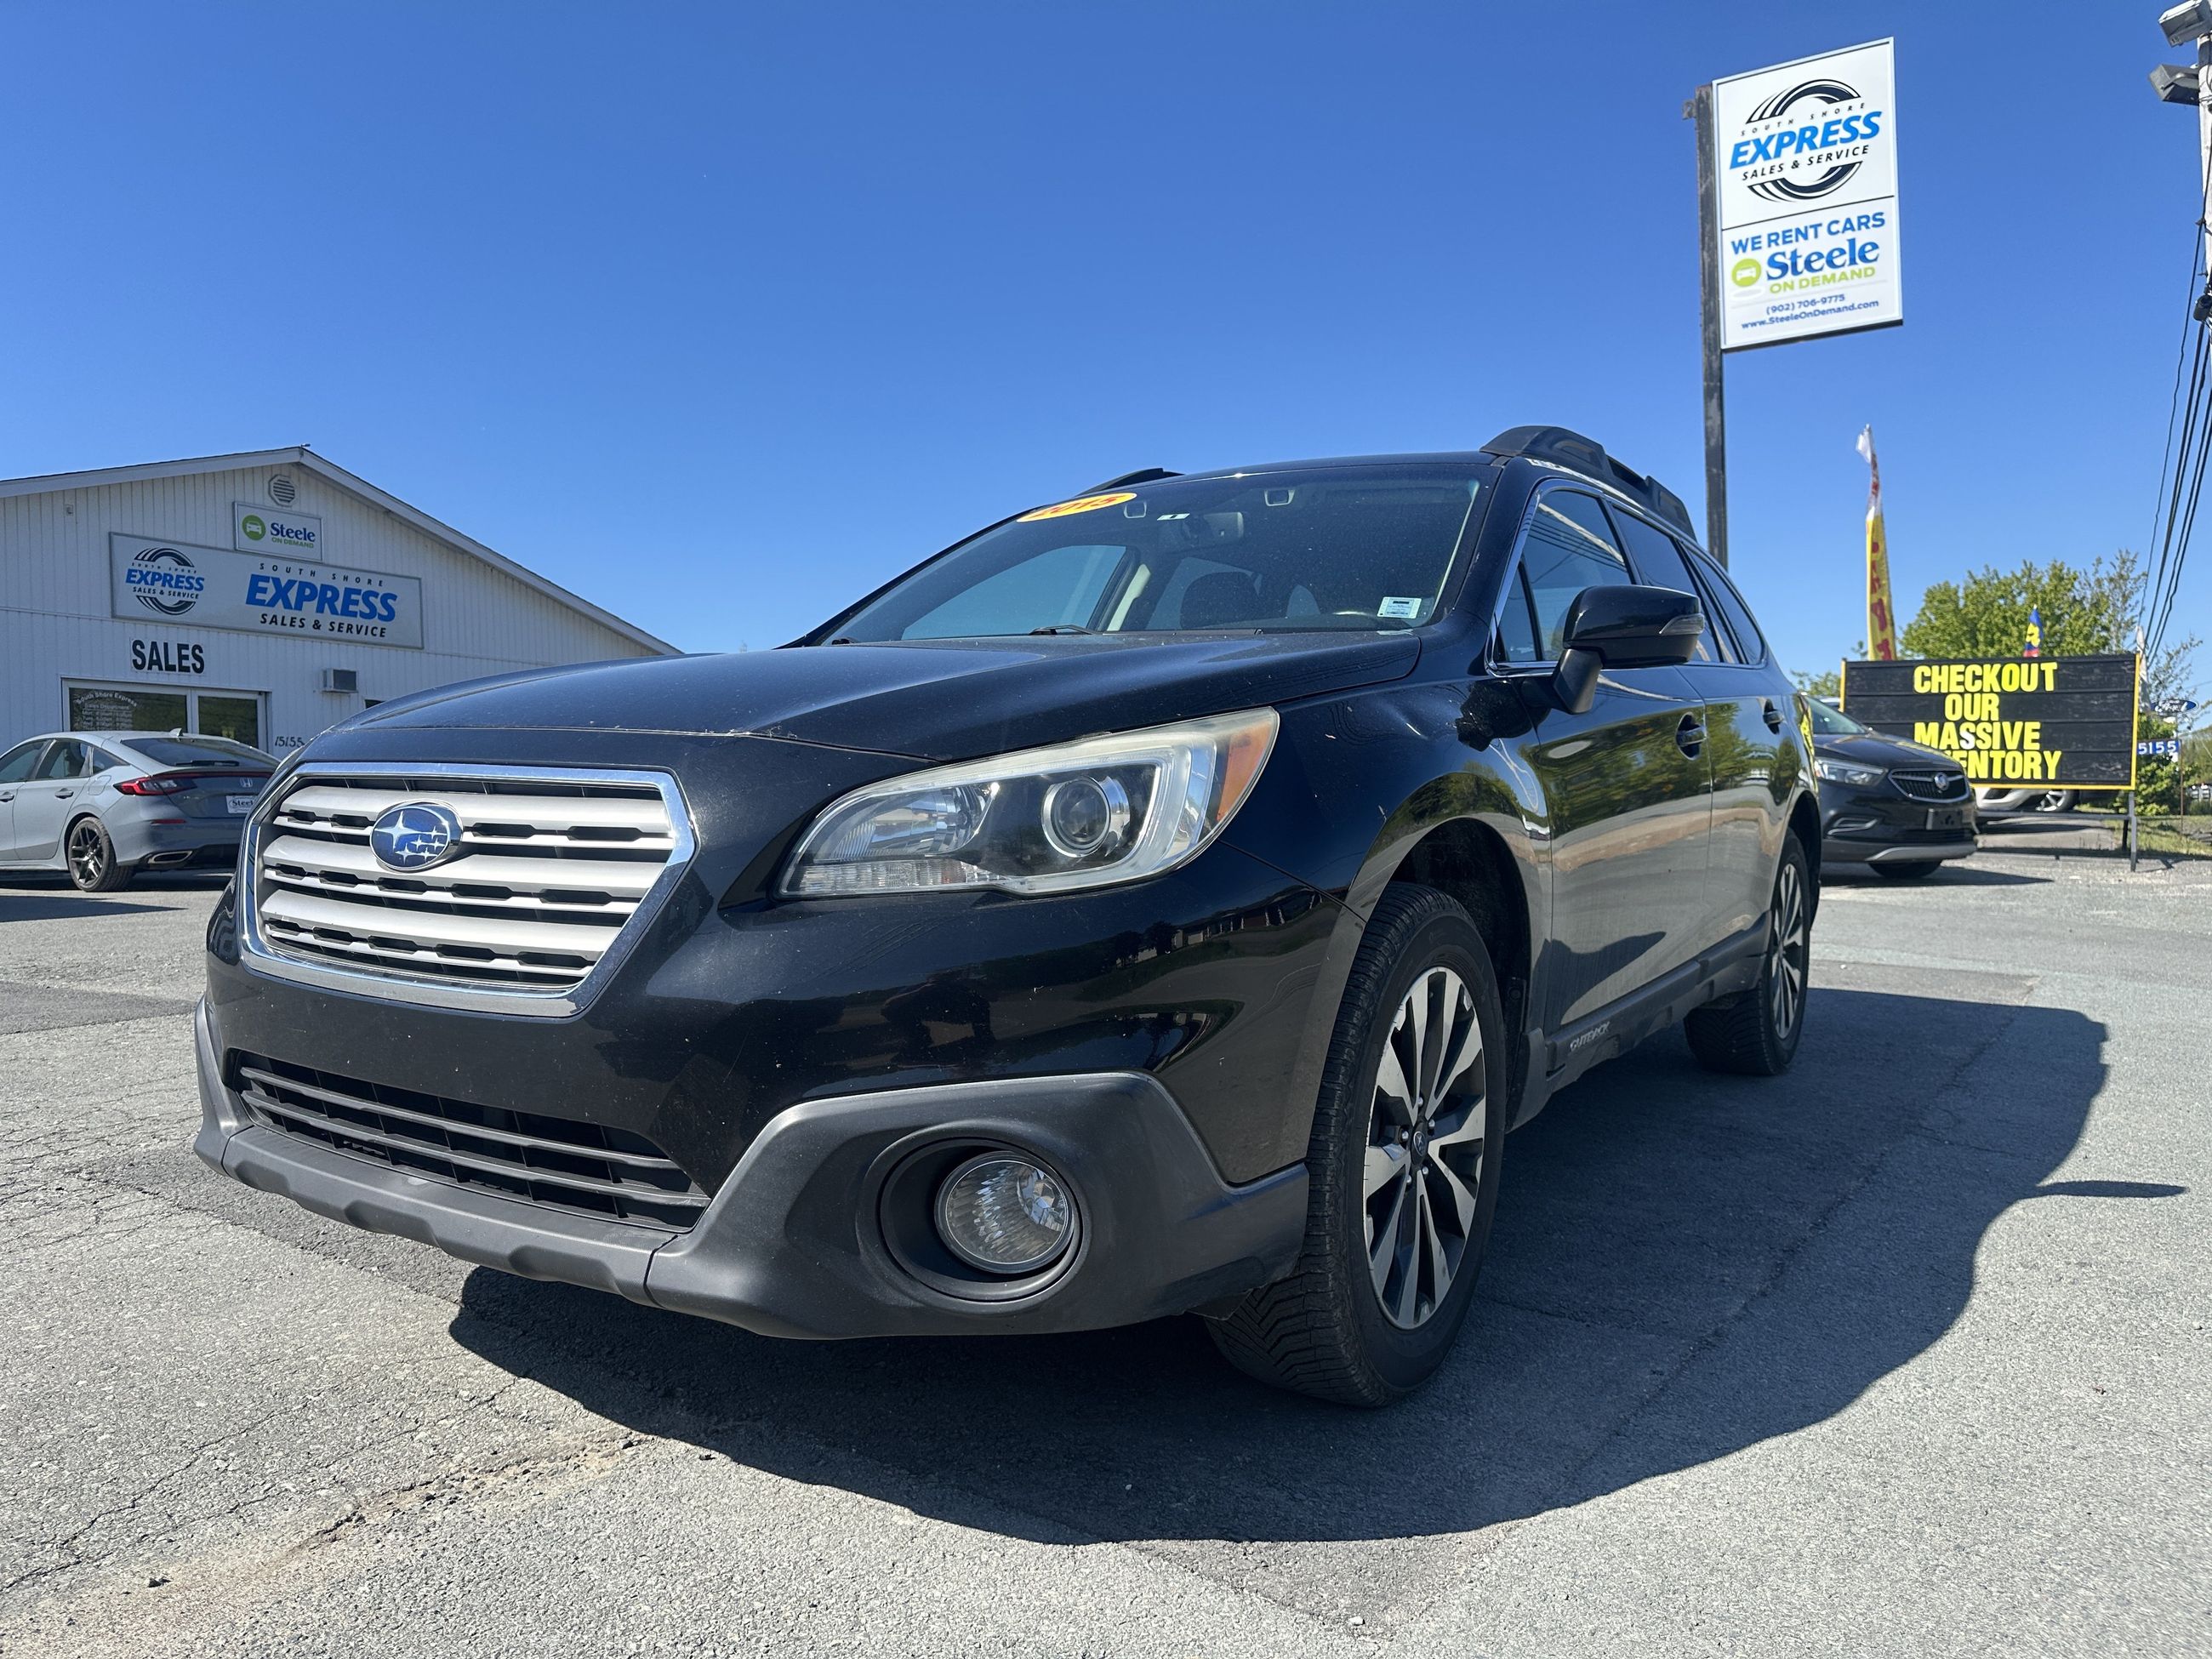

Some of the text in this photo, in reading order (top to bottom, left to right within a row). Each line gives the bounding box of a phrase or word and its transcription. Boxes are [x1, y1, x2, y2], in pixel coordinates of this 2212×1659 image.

[1741, 102, 1866, 137] SOUTH SHORE
[1730, 111, 1883, 170] EXPRESS
[1741, 145, 1870, 181] SALES & SERVICE
[1730, 211, 1886, 255] WE RENT CARS
[1765, 237, 1880, 282] Steele
[1769, 266, 1876, 294] ON DEMAND
[1741, 299, 1879, 329] www.SteeleOnDemand.com
[1765, 294, 1845, 316] (902) 706-9775
[270, 522, 316, 543] Steele
[271, 536, 314, 549] ON DEMAND
[125, 567, 205, 591] EXPRESS
[259, 562, 384, 587] SOUTH SHORE
[133, 586, 157, 595] SALES
[168, 590, 199, 600] SERVICE
[245, 573, 398, 623] EXPRESS
[259, 613, 387, 638] SALES & SERVICE
[131, 639, 205, 675] SALES
[1913, 662, 2058, 693] CHECKOUT
[1944, 693, 1999, 721] OUR
[274, 736, 305, 747] 15155
[1914, 721, 2041, 750] MASSIVE
[1944, 750, 2062, 780] ENTORY
